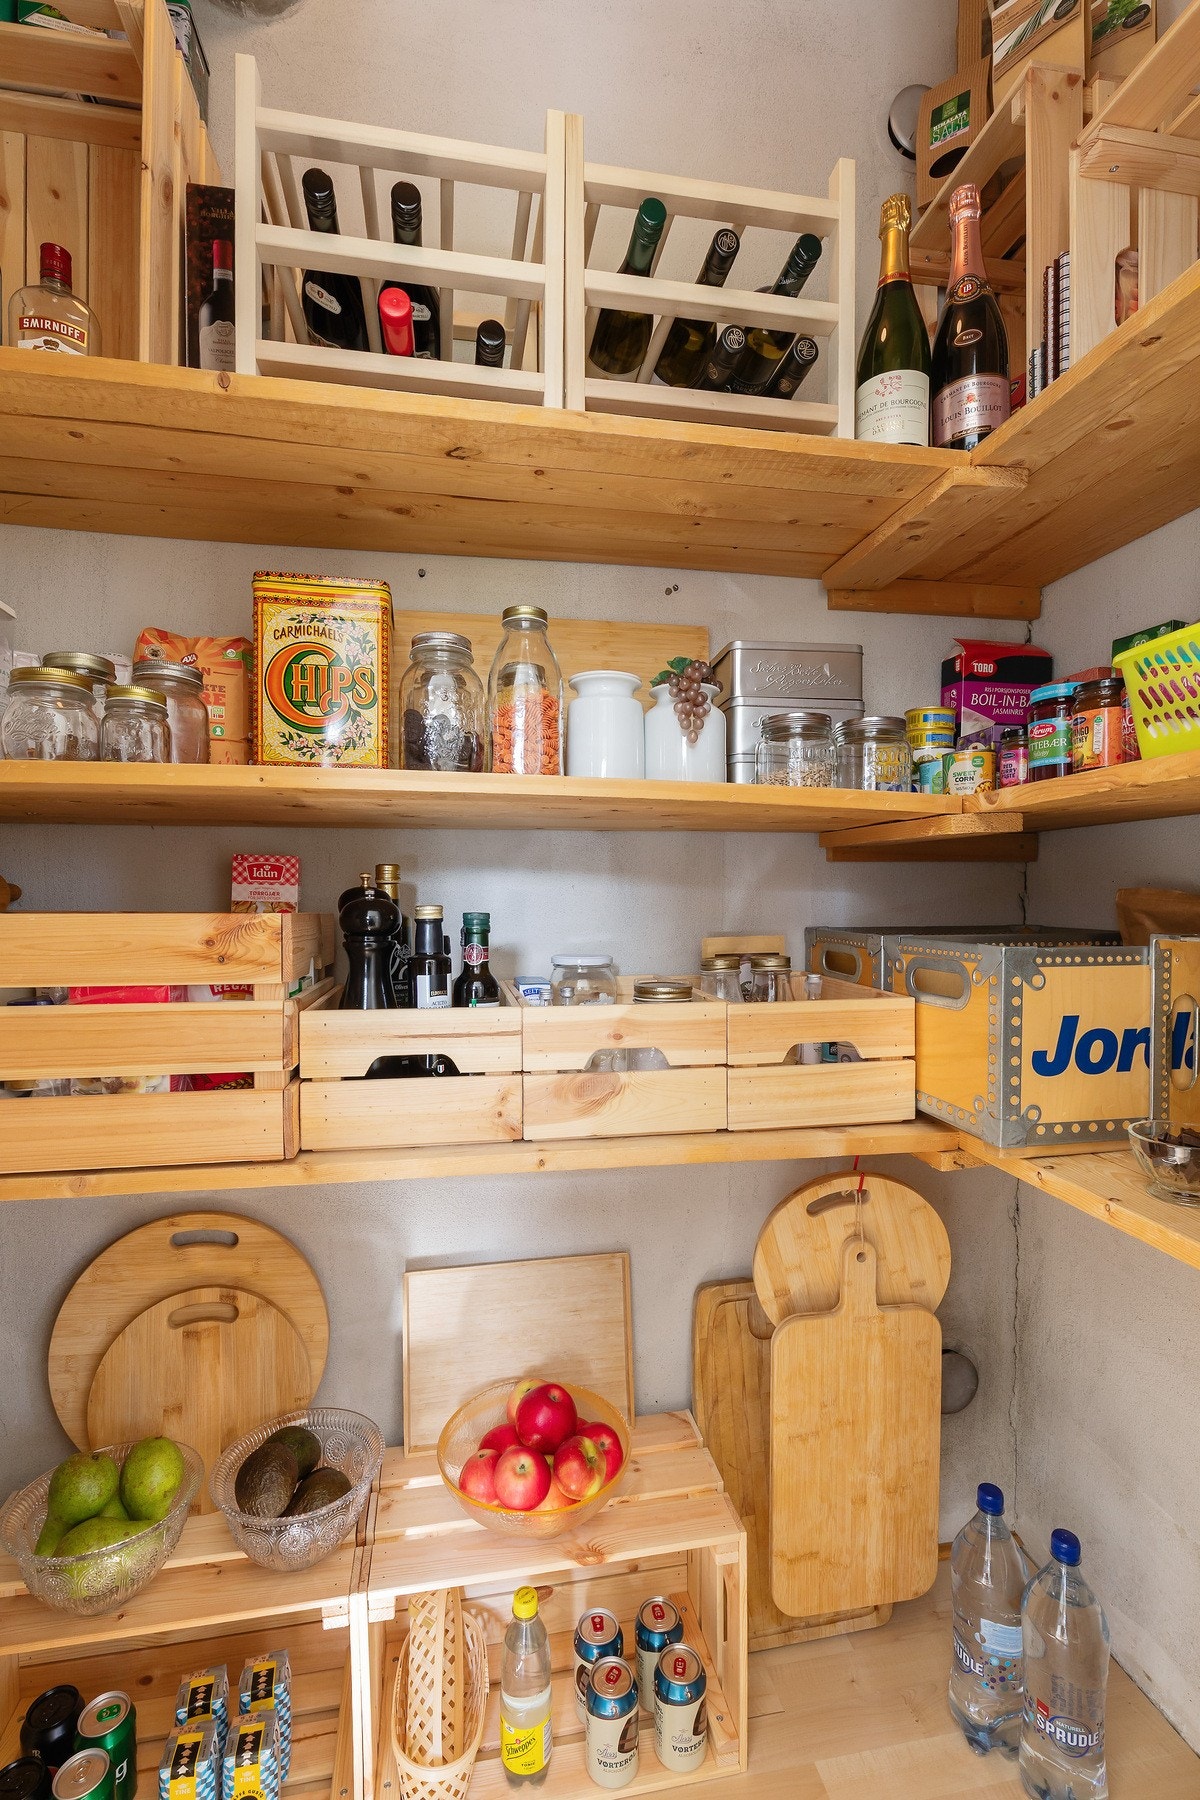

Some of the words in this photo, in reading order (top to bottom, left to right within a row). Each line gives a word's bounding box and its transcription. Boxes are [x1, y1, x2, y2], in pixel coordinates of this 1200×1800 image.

[932, 114, 969, 144] SALT
[23, 318, 81, 340] SMIRNOFF
[879, 401, 888, 409] DE
[940, 411, 962, 427] LOUIS
[964, 404, 1003, 415] BOUILLOT
[273, 624, 344, 644] CARMICHAEL'S
[181, 653, 198, 664] AXA
[973, 662, 994, 673] TORO
[264, 641, 379, 734] CHIPS
[992, 708, 1024, 716] JASMINRIS
[952, 769, 977, 778] SWEET
[252, 867, 278, 878] Idun
[1036, 1713, 1099, 1747] SPRUDLE
[1055, 1720, 1086, 1733] NATURELL
[505, 1737, 536, 1756] Schweppes
